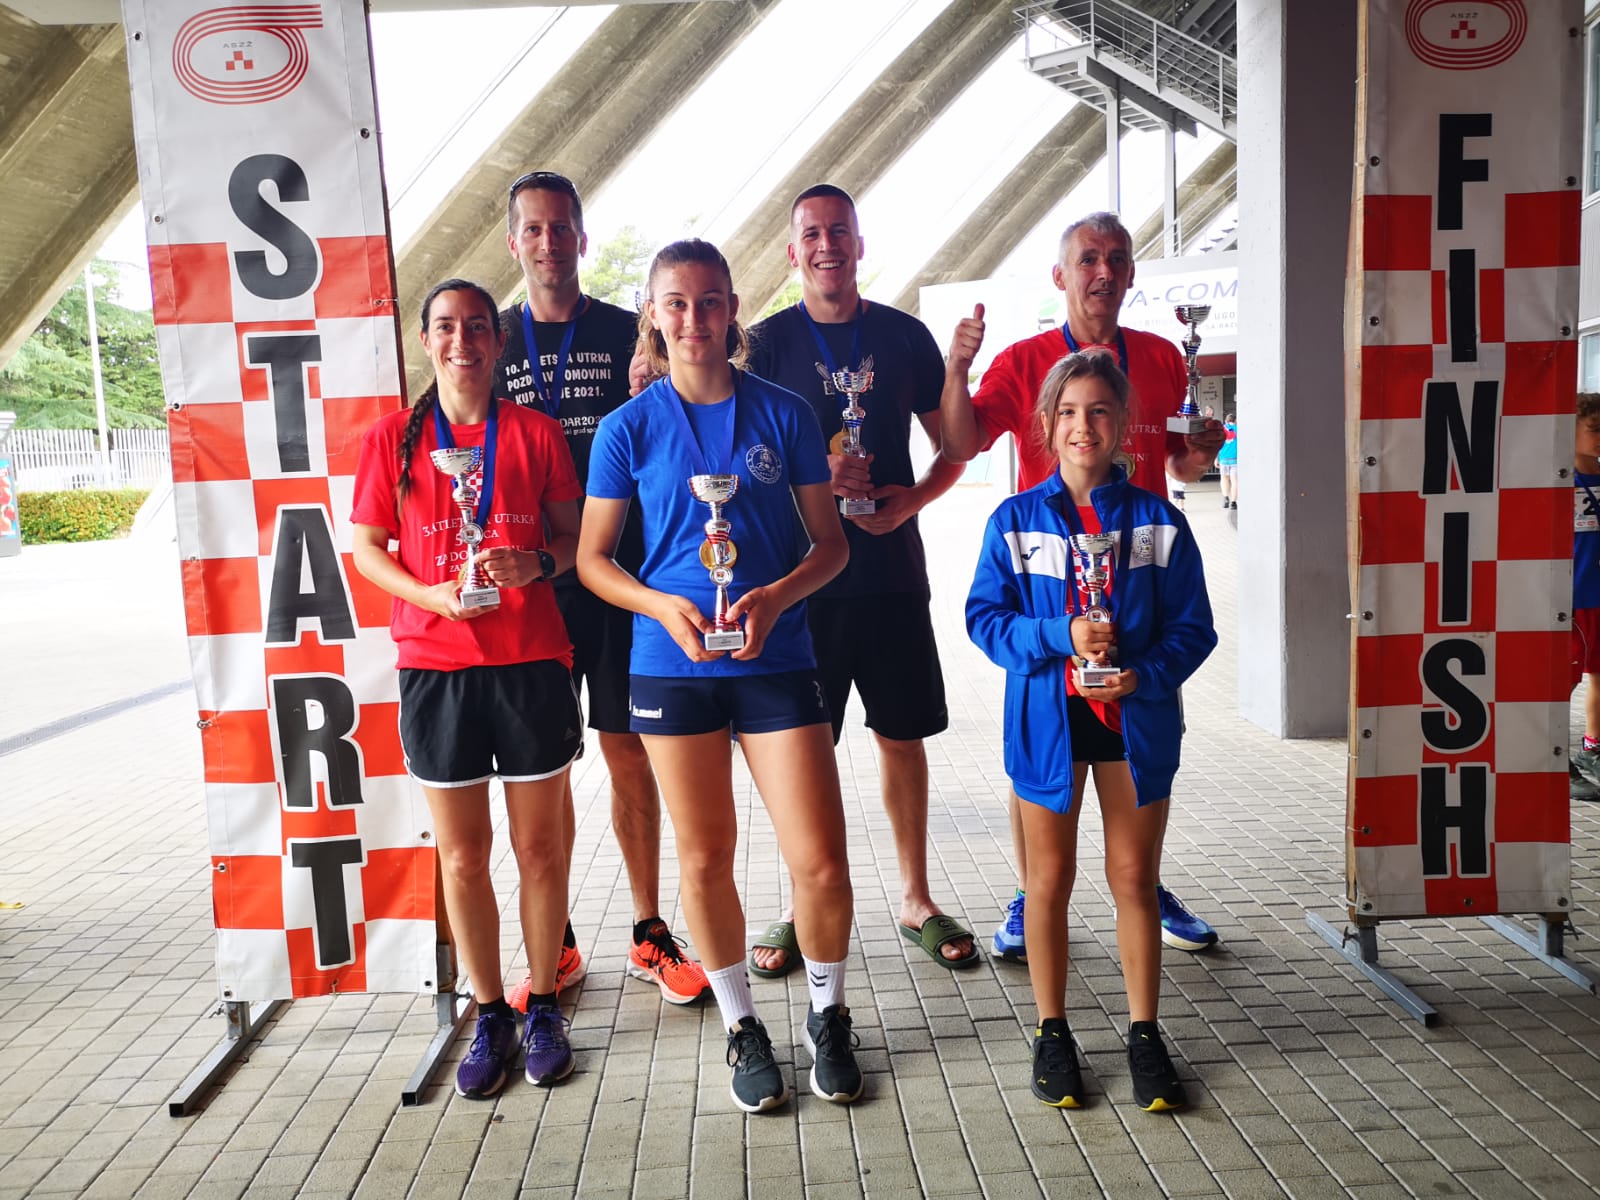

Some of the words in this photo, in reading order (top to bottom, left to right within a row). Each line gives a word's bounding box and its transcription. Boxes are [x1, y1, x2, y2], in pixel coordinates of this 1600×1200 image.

[505, 363, 520, 376] 10.
[523, 353, 573, 371] AETSA
[576, 352, 612, 364] UTRKA
[506, 370, 554, 392] POZDV
[564, 368, 612, 381] OMOVINI
[515, 391, 535, 406] KUP
[573, 386, 604, 398] 2021.
[1420, 113, 1500, 877] FINISH
[227, 153, 365, 968] START
